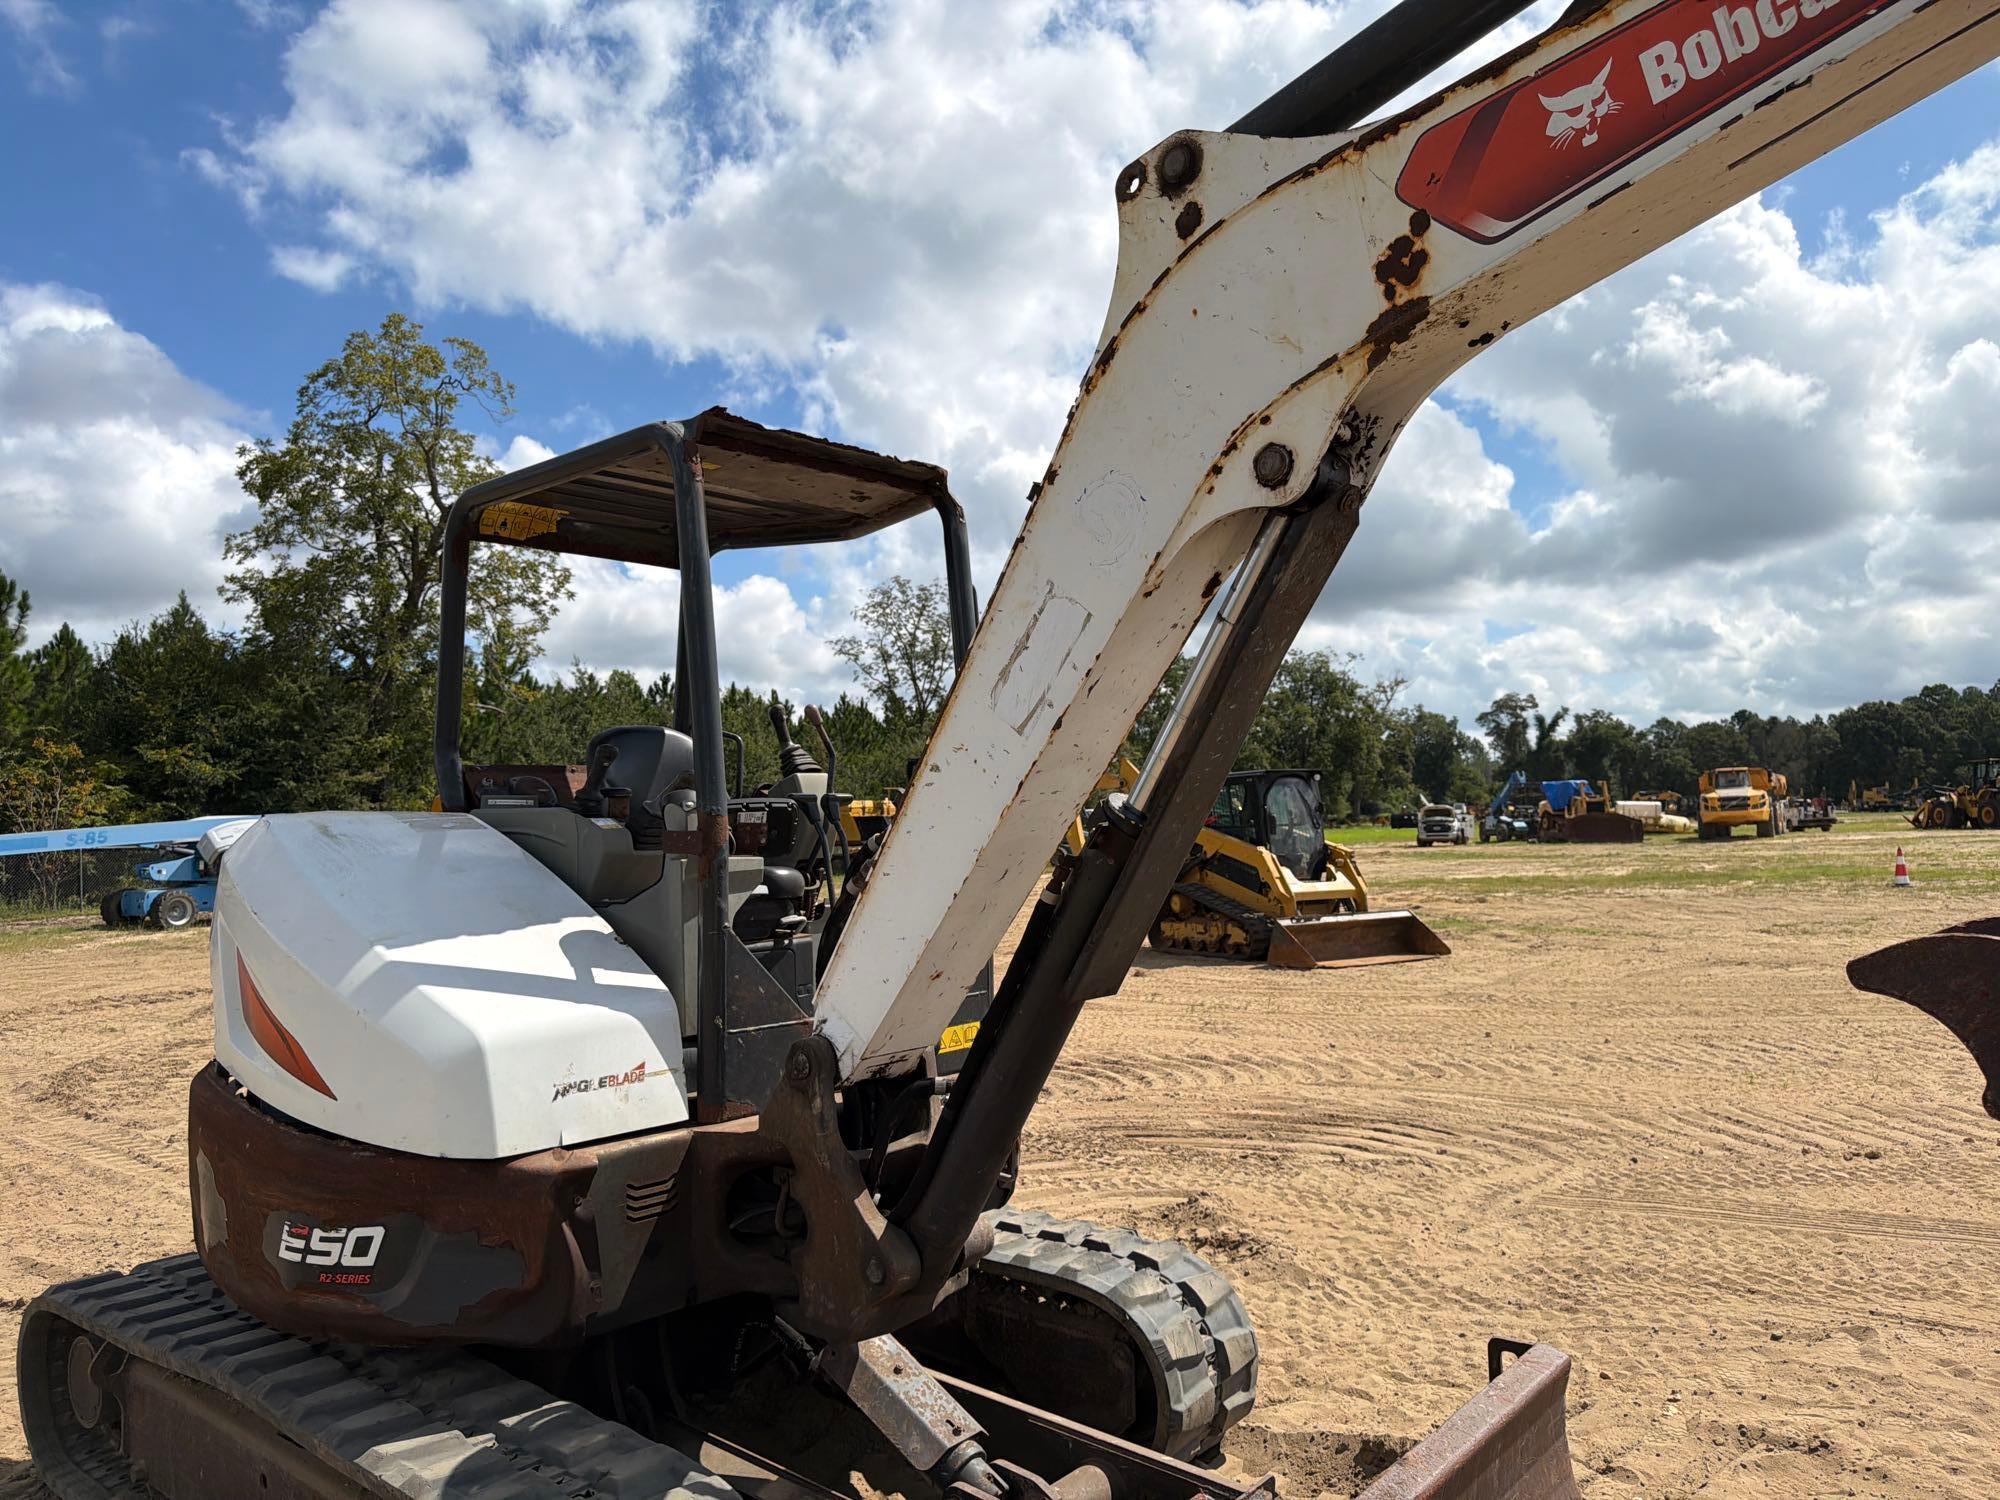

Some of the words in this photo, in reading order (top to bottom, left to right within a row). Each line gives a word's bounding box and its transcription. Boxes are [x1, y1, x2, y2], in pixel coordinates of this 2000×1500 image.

[66, 831, 108, 847] S-85
[552, 1067, 646, 1102] ANGEBLADE
[278, 1221, 386, 1266] E50
[319, 1273, 371, 1284] R2-SERIES
